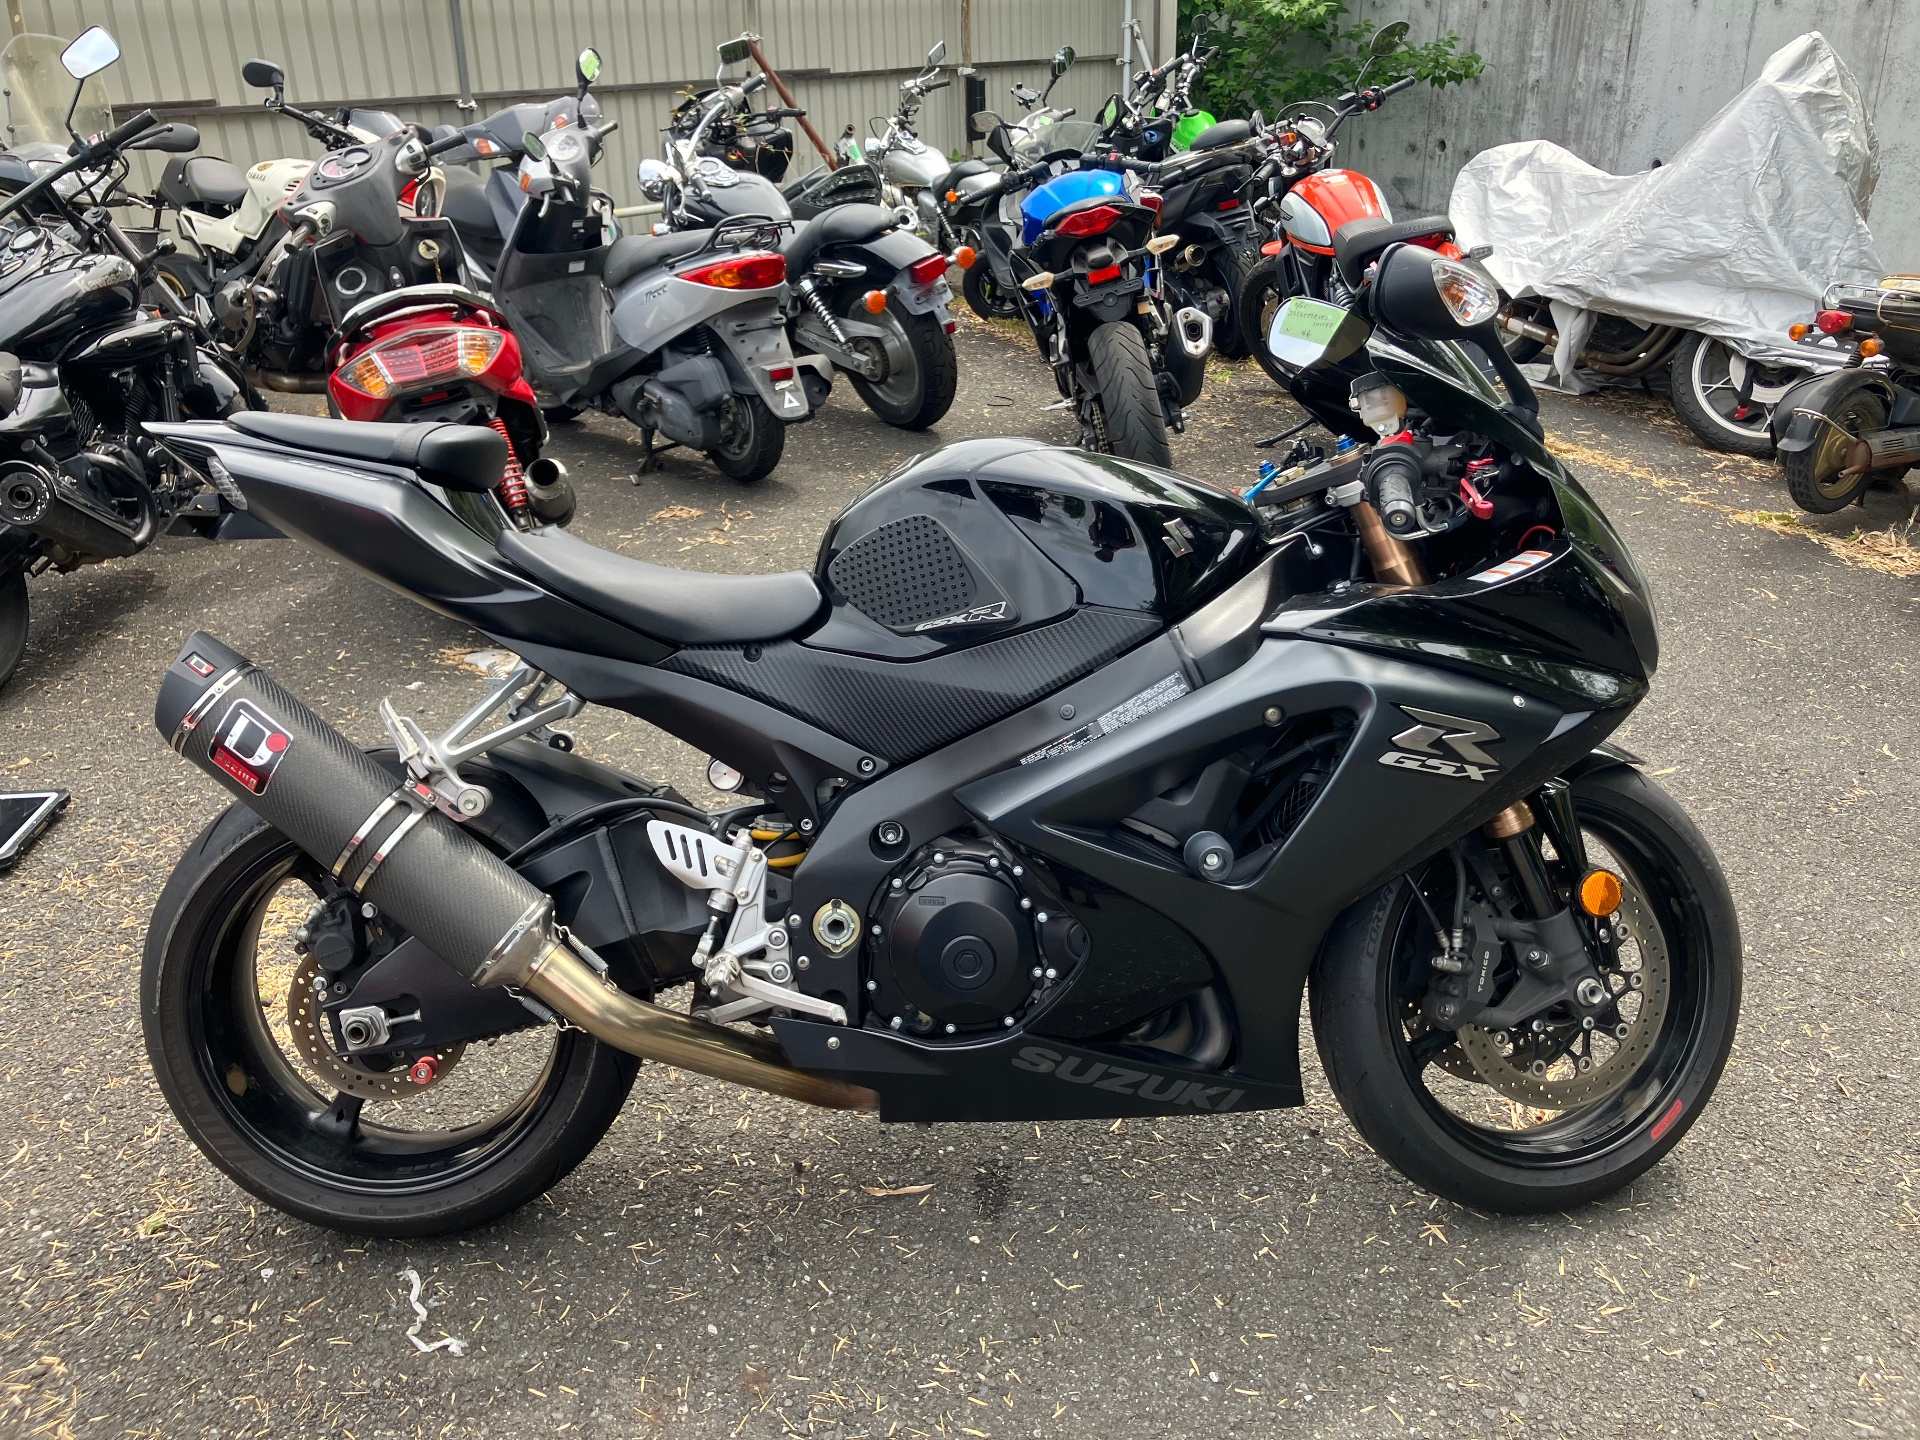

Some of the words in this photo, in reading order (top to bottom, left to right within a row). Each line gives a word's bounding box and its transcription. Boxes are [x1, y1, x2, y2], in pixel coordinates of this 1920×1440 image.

[248, 171, 267, 182] YAMAHA
[1378, 751, 1500, 781] GSX
[1365, 884, 1395, 960] CORSA
[1477, 950, 1490, 993] TOKICO
[1011, 1046, 1246, 1112] SUZUKI
